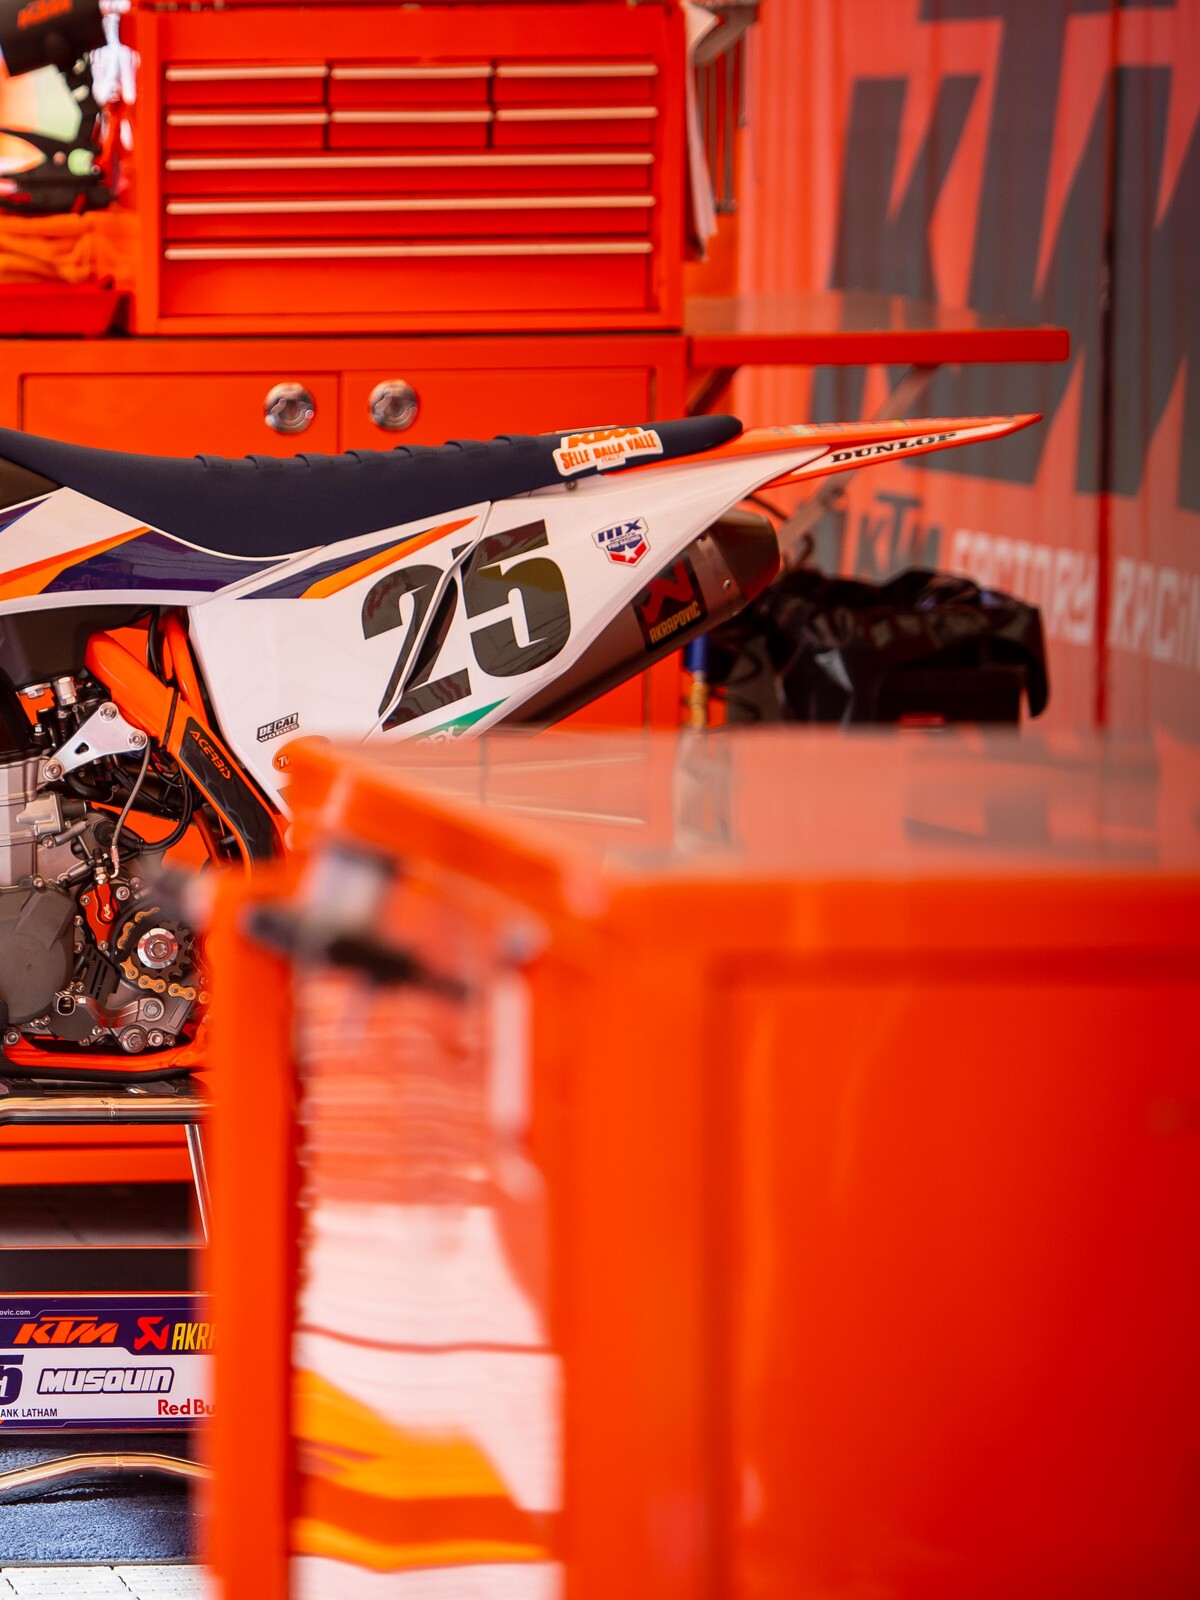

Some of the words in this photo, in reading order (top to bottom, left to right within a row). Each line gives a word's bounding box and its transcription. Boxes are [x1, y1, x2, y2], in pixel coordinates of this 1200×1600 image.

[560, 449, 591, 470] SELLE
[593, 442, 626, 459] DALLA
[626, 433, 658, 451] VALLE
[831, 431, 956, 463] DUNLOP
[361, 519, 571, 732] 25
[190, 730, 231, 780] ACERBIS
[13, 1316, 120, 1345] KTM
[21, 1408, 58, 1418] LATHAM
[157, 1398, 191, 1416] Red
